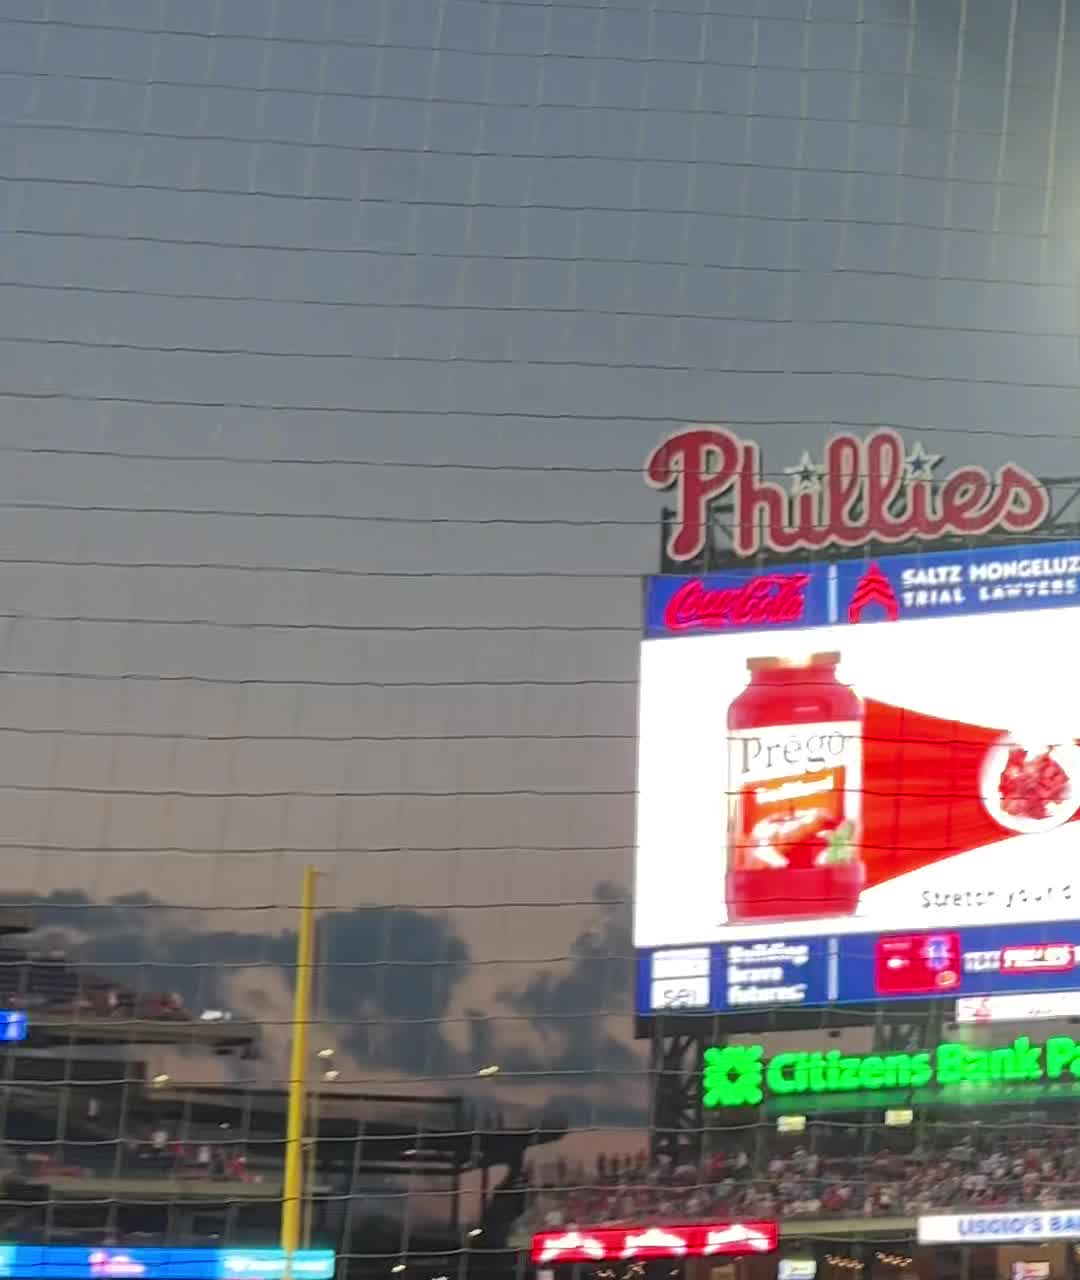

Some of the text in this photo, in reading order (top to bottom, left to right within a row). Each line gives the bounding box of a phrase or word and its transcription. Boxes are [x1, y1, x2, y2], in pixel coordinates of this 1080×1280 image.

[645, 426, 1051, 562] Phillies
[902, 565, 962, 588] SALTZ
[902, 589, 966, 608] TRIAL
[741, 731, 847, 774] Prego
[766, 1049, 932, 1094] Citizens
[936, 1037, 1042, 1083] Bank
[958, 1215, 1043, 1236] LISCIO'S
